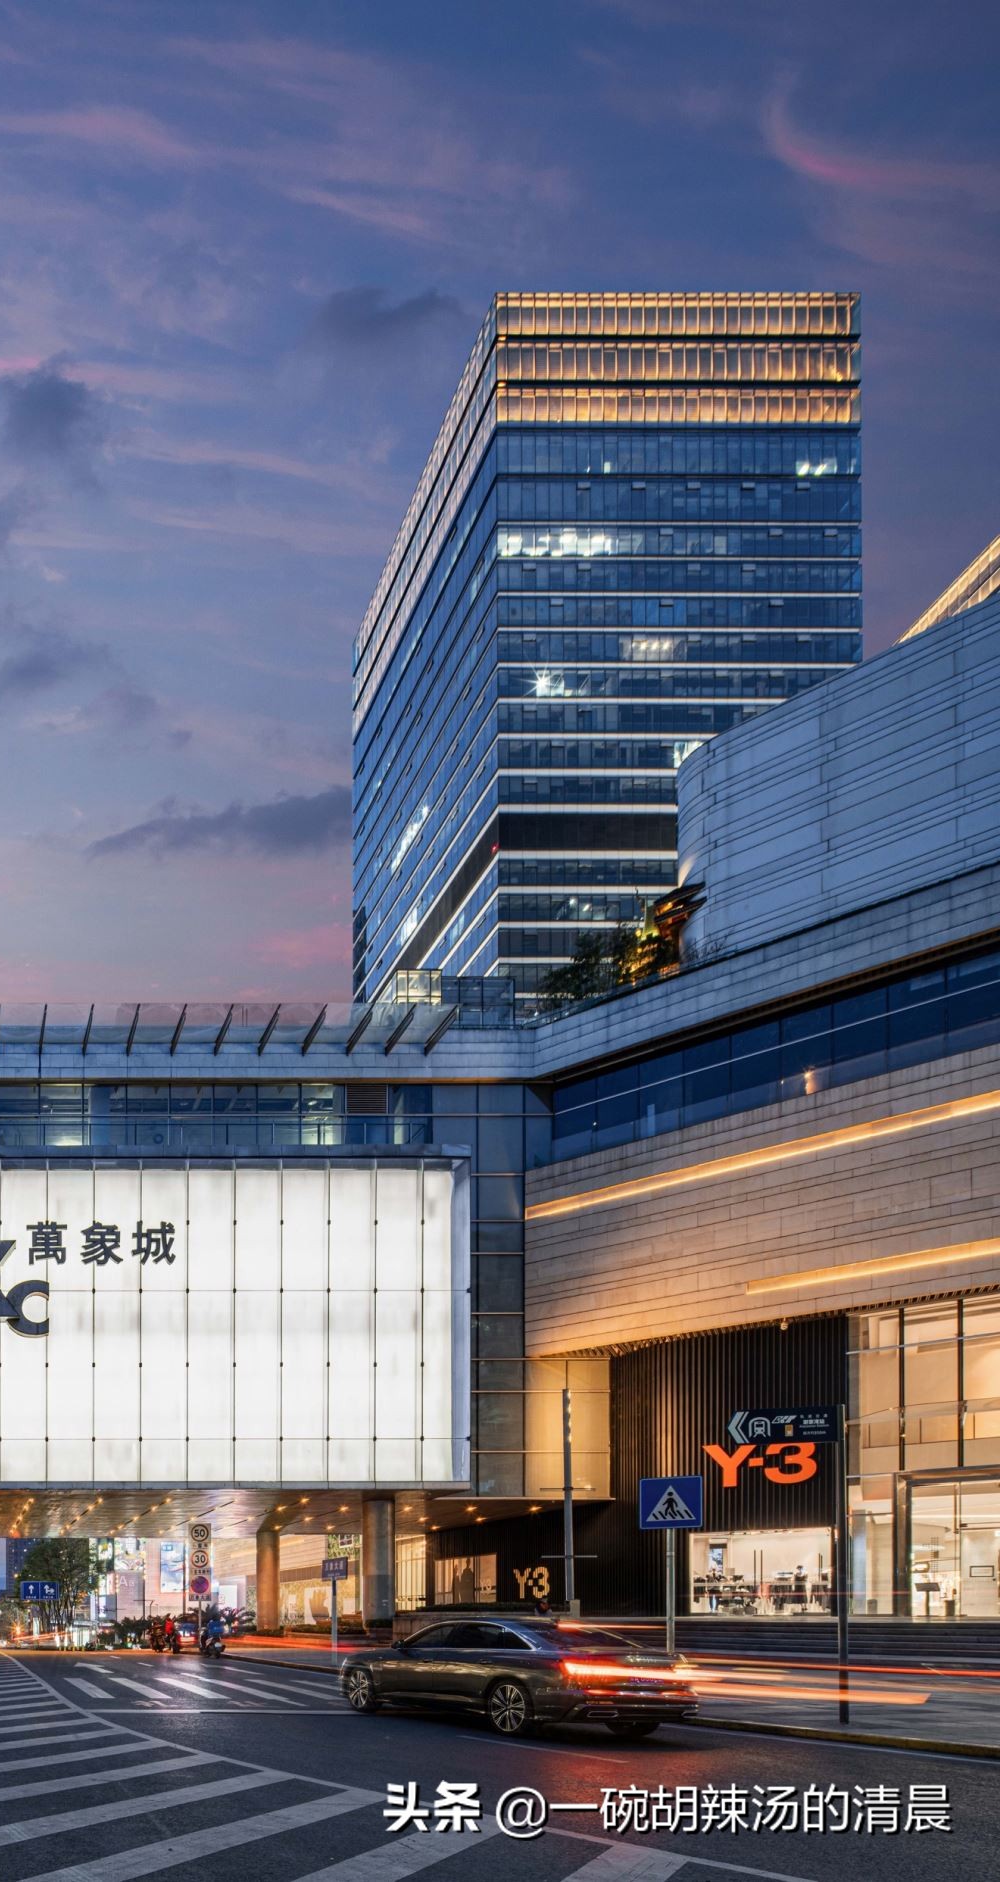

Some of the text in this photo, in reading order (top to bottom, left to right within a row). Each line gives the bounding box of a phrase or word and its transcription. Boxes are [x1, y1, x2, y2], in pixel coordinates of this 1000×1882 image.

[26, 1220, 176, 1266] 萬象城
[702, 1442, 818, 1488] Y-3
[194, 1529, 206, 1538] 50
[194, 1554, 206, 1563] 30
[513, 1566, 551, 1599] Y-3
